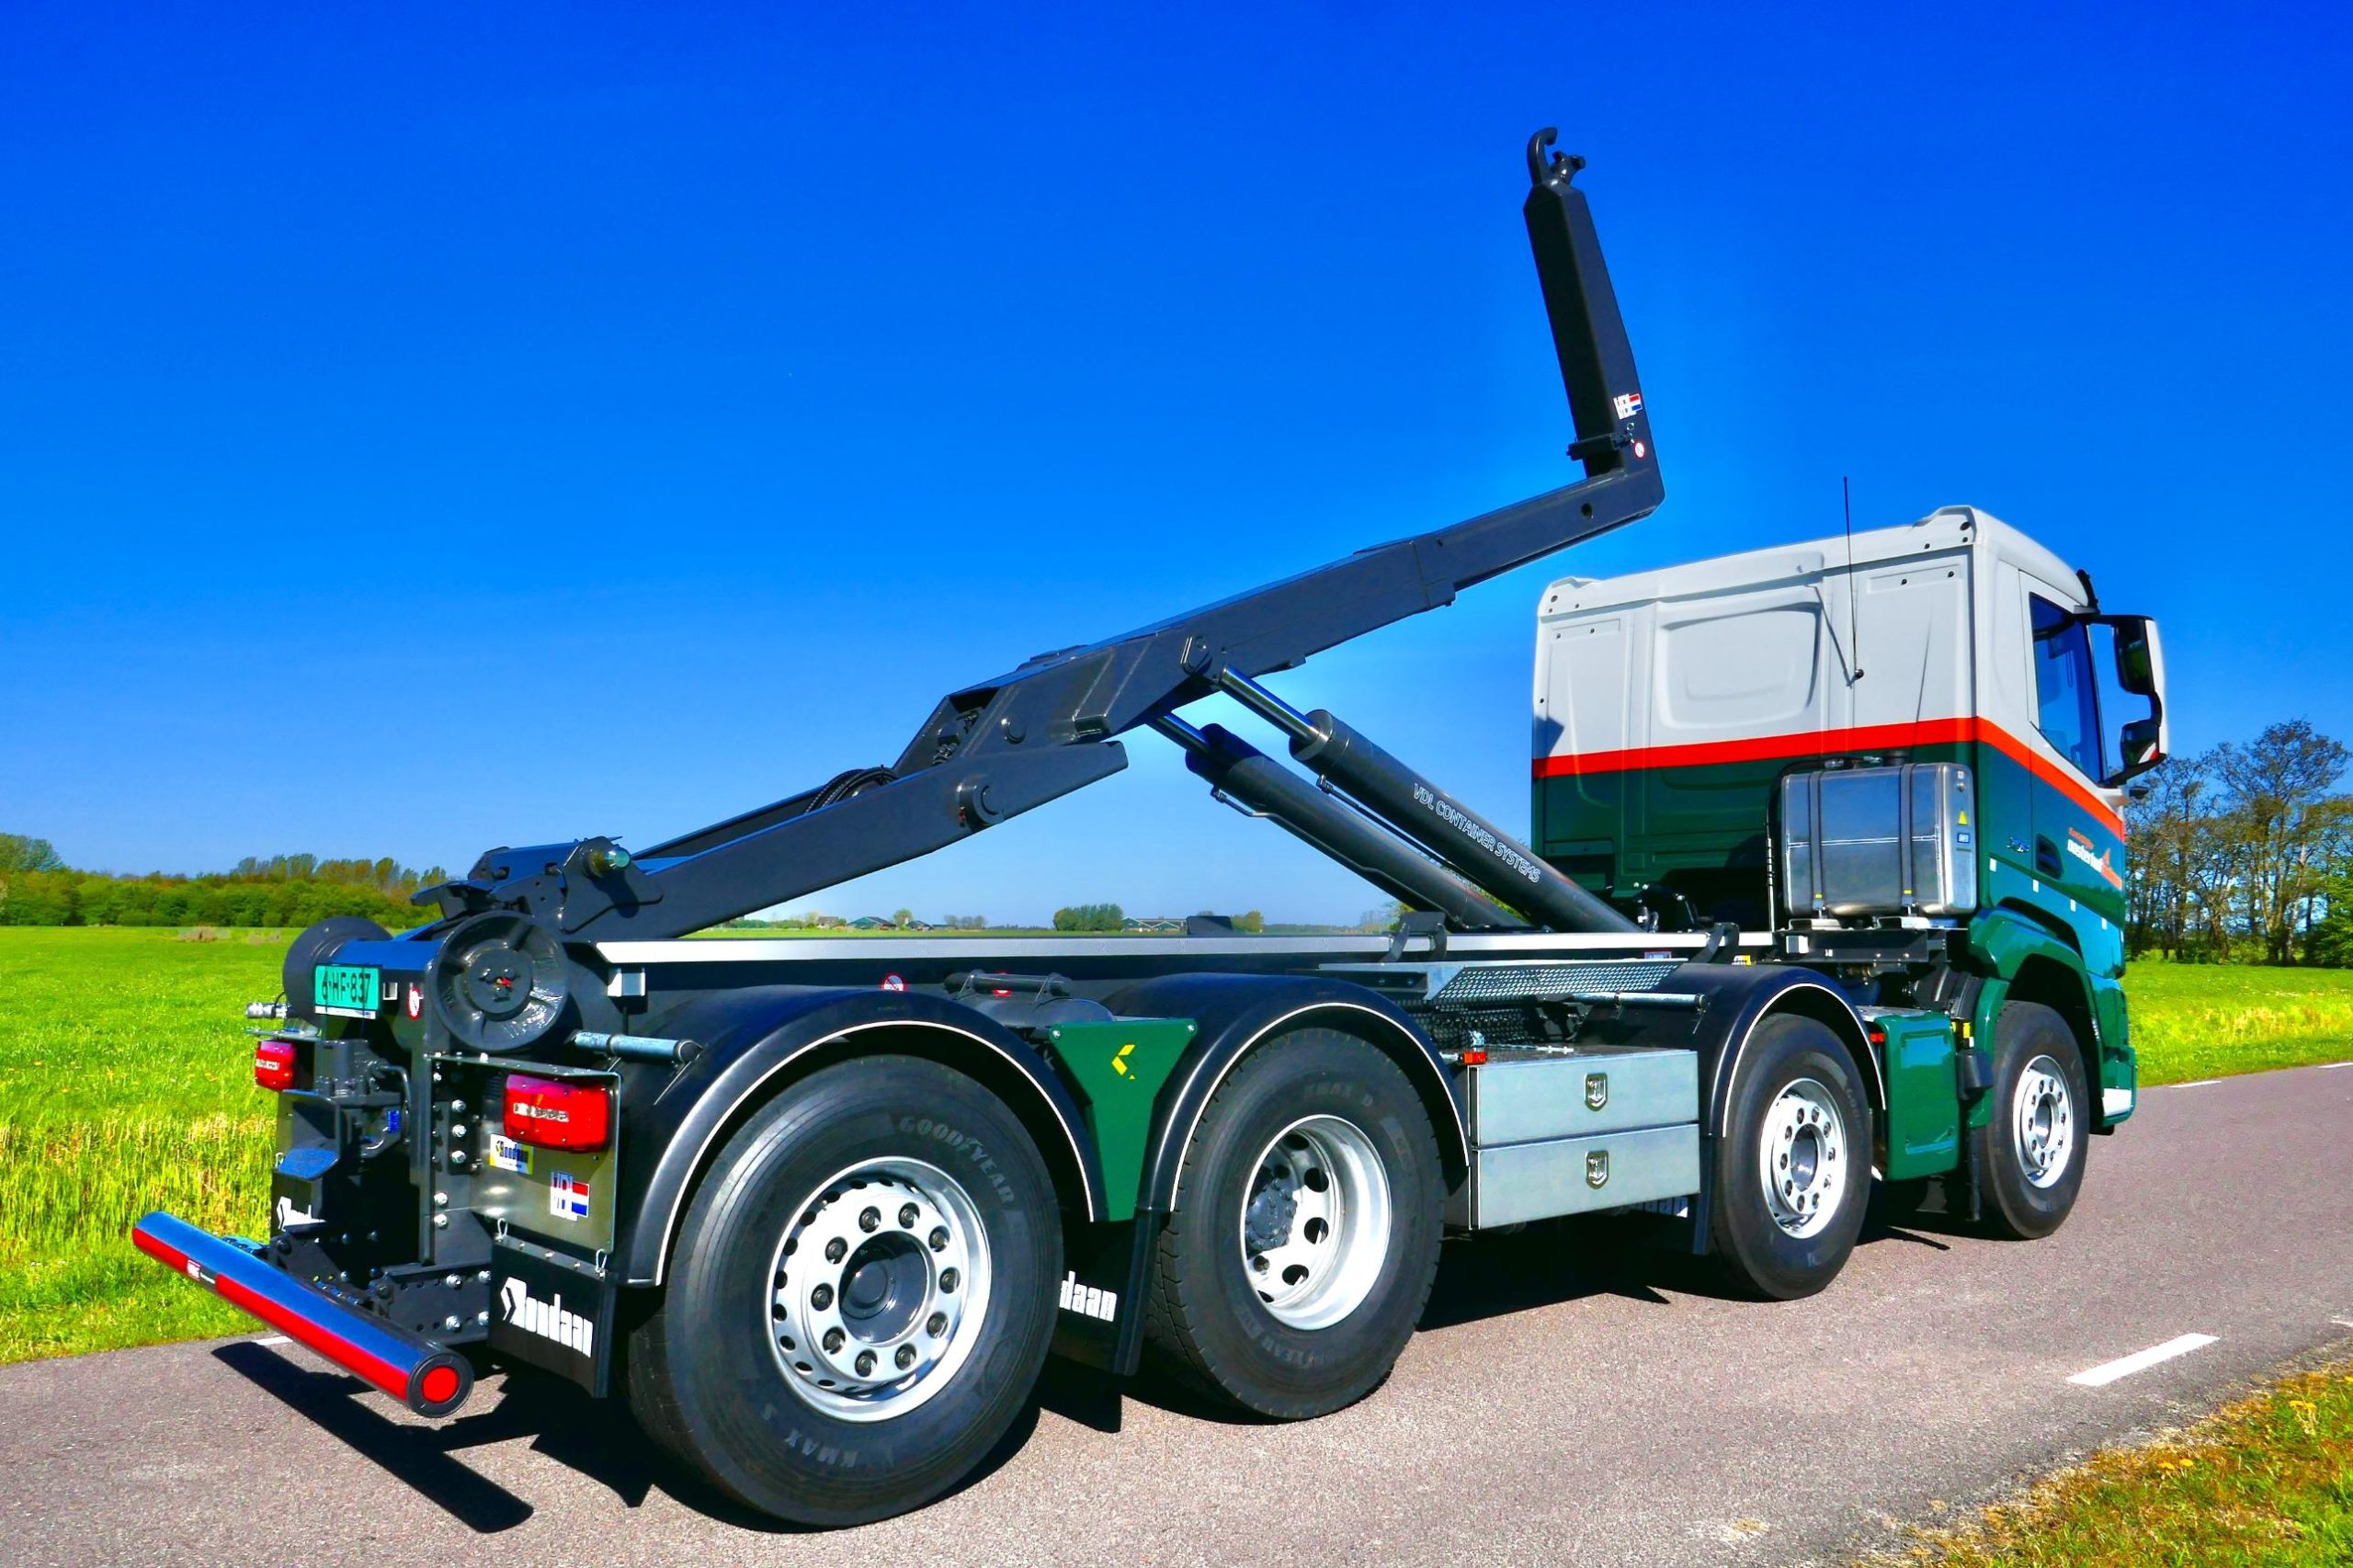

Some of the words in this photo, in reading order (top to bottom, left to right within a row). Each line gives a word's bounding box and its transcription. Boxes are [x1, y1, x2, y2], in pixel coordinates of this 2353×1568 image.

[1413, 782, 1435, 811] VDL
[1436, 800, 1496, 853] CONTAINER
[1495, 841, 1541, 883] SYSTEMS
[899, 1115, 1016, 1204] GOODYEAR
[1059, 1270, 1117, 1323] daan
[784, 1428, 859, 1469] KMAX
